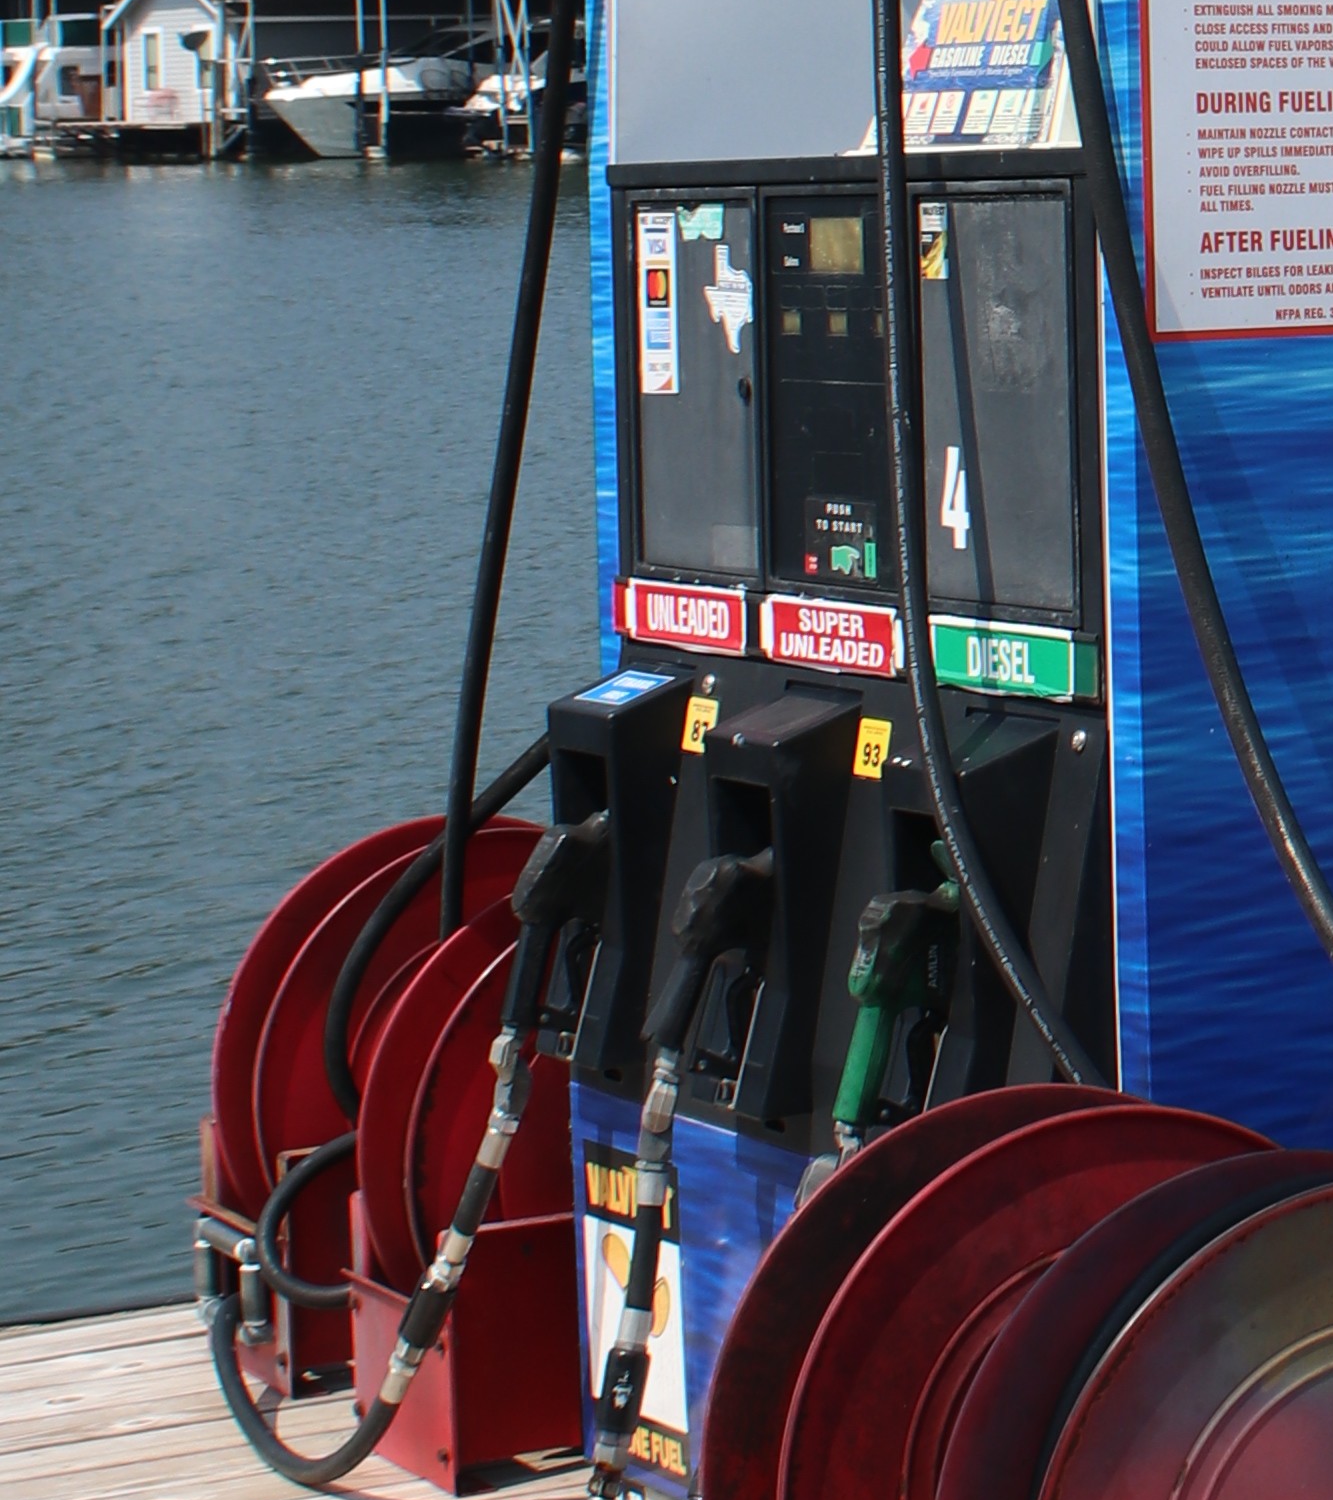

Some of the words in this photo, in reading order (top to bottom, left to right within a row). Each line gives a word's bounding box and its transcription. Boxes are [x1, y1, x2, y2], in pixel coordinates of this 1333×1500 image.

[1193, 4, 1253, 16] EXTINGUISH
[1256, 4, 1274, 15] ALL
[1277, 4, 1323, 16] SMOKING
[1194, 23, 1226, 35] CLOSE
[1229, 23, 1268, 34] ACCESS
[1312, 22, 1332, 34] AND
[1195, 40, 1228, 52] COULD
[1231, 40, 1265, 51] ALLOW
[1268, 39, 1293, 51] FUEL
[1294, 39, 1333, 51] VAPORS
[929, 45, 986, 69] GASOLINE
[989, 43, 1031, 67] DIESEL
[1195, 57, 1247, 69] ENCLOSED
[1250, 56, 1288, 69] SPACES
[1291, 56, 1304, 68] OF
[1307, 56, 1325, 68] THE
[1197, 91, 1272, 114] DURING
[1197, 128, 1246, 139] MAINTAIN
[1249, 127, 1286, 139] NOZZLE
[1289, 126, 1333, 138] CONTACT
[1199, 147, 1223, 159] WIPE
[1228, 146, 1240, 158] UP
[1245, 145, 1277, 158] SPILLS
[1199, 165, 1230, 177] AVOID
[1232, 164, 1300, 177] OVERFILLING.
[1199, 184, 1225, 196] FUEL
[1228, 183, 1265, 195] FILLING
[1268, 182, 1306, 195] NOZZLE
[1201, 200, 1217, 212] ALL
[1220, 199, 1255, 211] TIMES.
[1201, 230, 1262, 253] AFTER
[1200, 267, 1243, 280] INSPECT
[1246, 265, 1280, 278] BILGES
[1283, 264, 1303, 277] FOR
[1201, 285, 1253, 298] VENTILATE
[1257, 284, 1285, 296] UNTIL
[1289, 282, 1321, 295] ODORS
[1303, 307, 1327, 319] REG.
[941, 446, 970, 549] 4
[825, 502, 852, 516] PUSH
[815, 518, 829, 531] TO
[831, 520, 863, 534] START
[647, 593, 730, 639] UNLEADED
[798, 608, 864, 638] SUPER
[780, 632, 885, 668] UNLEADED
[966, 636, 1035, 684] DIESEL
[863, 742, 881, 767] 93
[650, 1431, 687, 1477] FUEL
